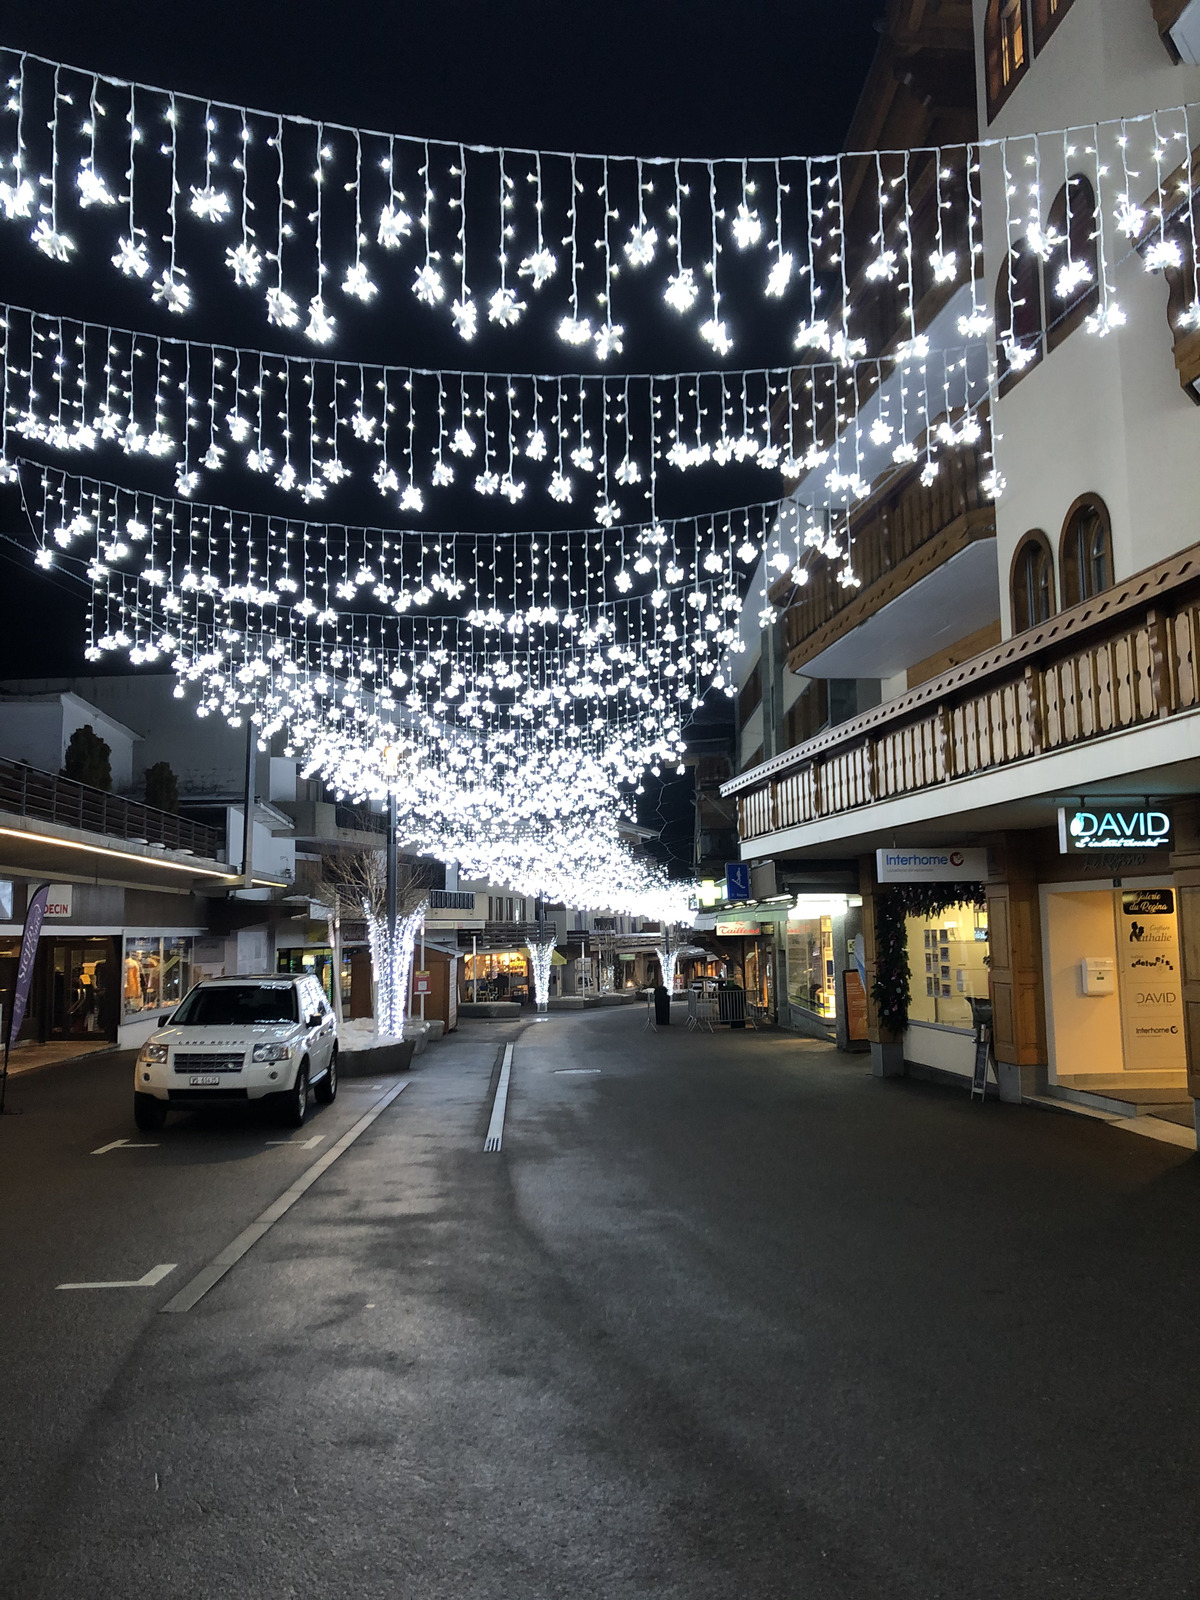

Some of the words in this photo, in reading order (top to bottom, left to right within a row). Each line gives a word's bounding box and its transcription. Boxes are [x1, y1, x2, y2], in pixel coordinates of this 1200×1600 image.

[1071, 812, 1170, 836] DAVID
[886, 854, 948, 866] Interhome
[1135, 891, 1161, 903] Galerie
[1129, 902, 1139, 911] du
[1131, 954, 1174, 971] edelweiss
[1136, 992, 1177, 1003] DAVID
